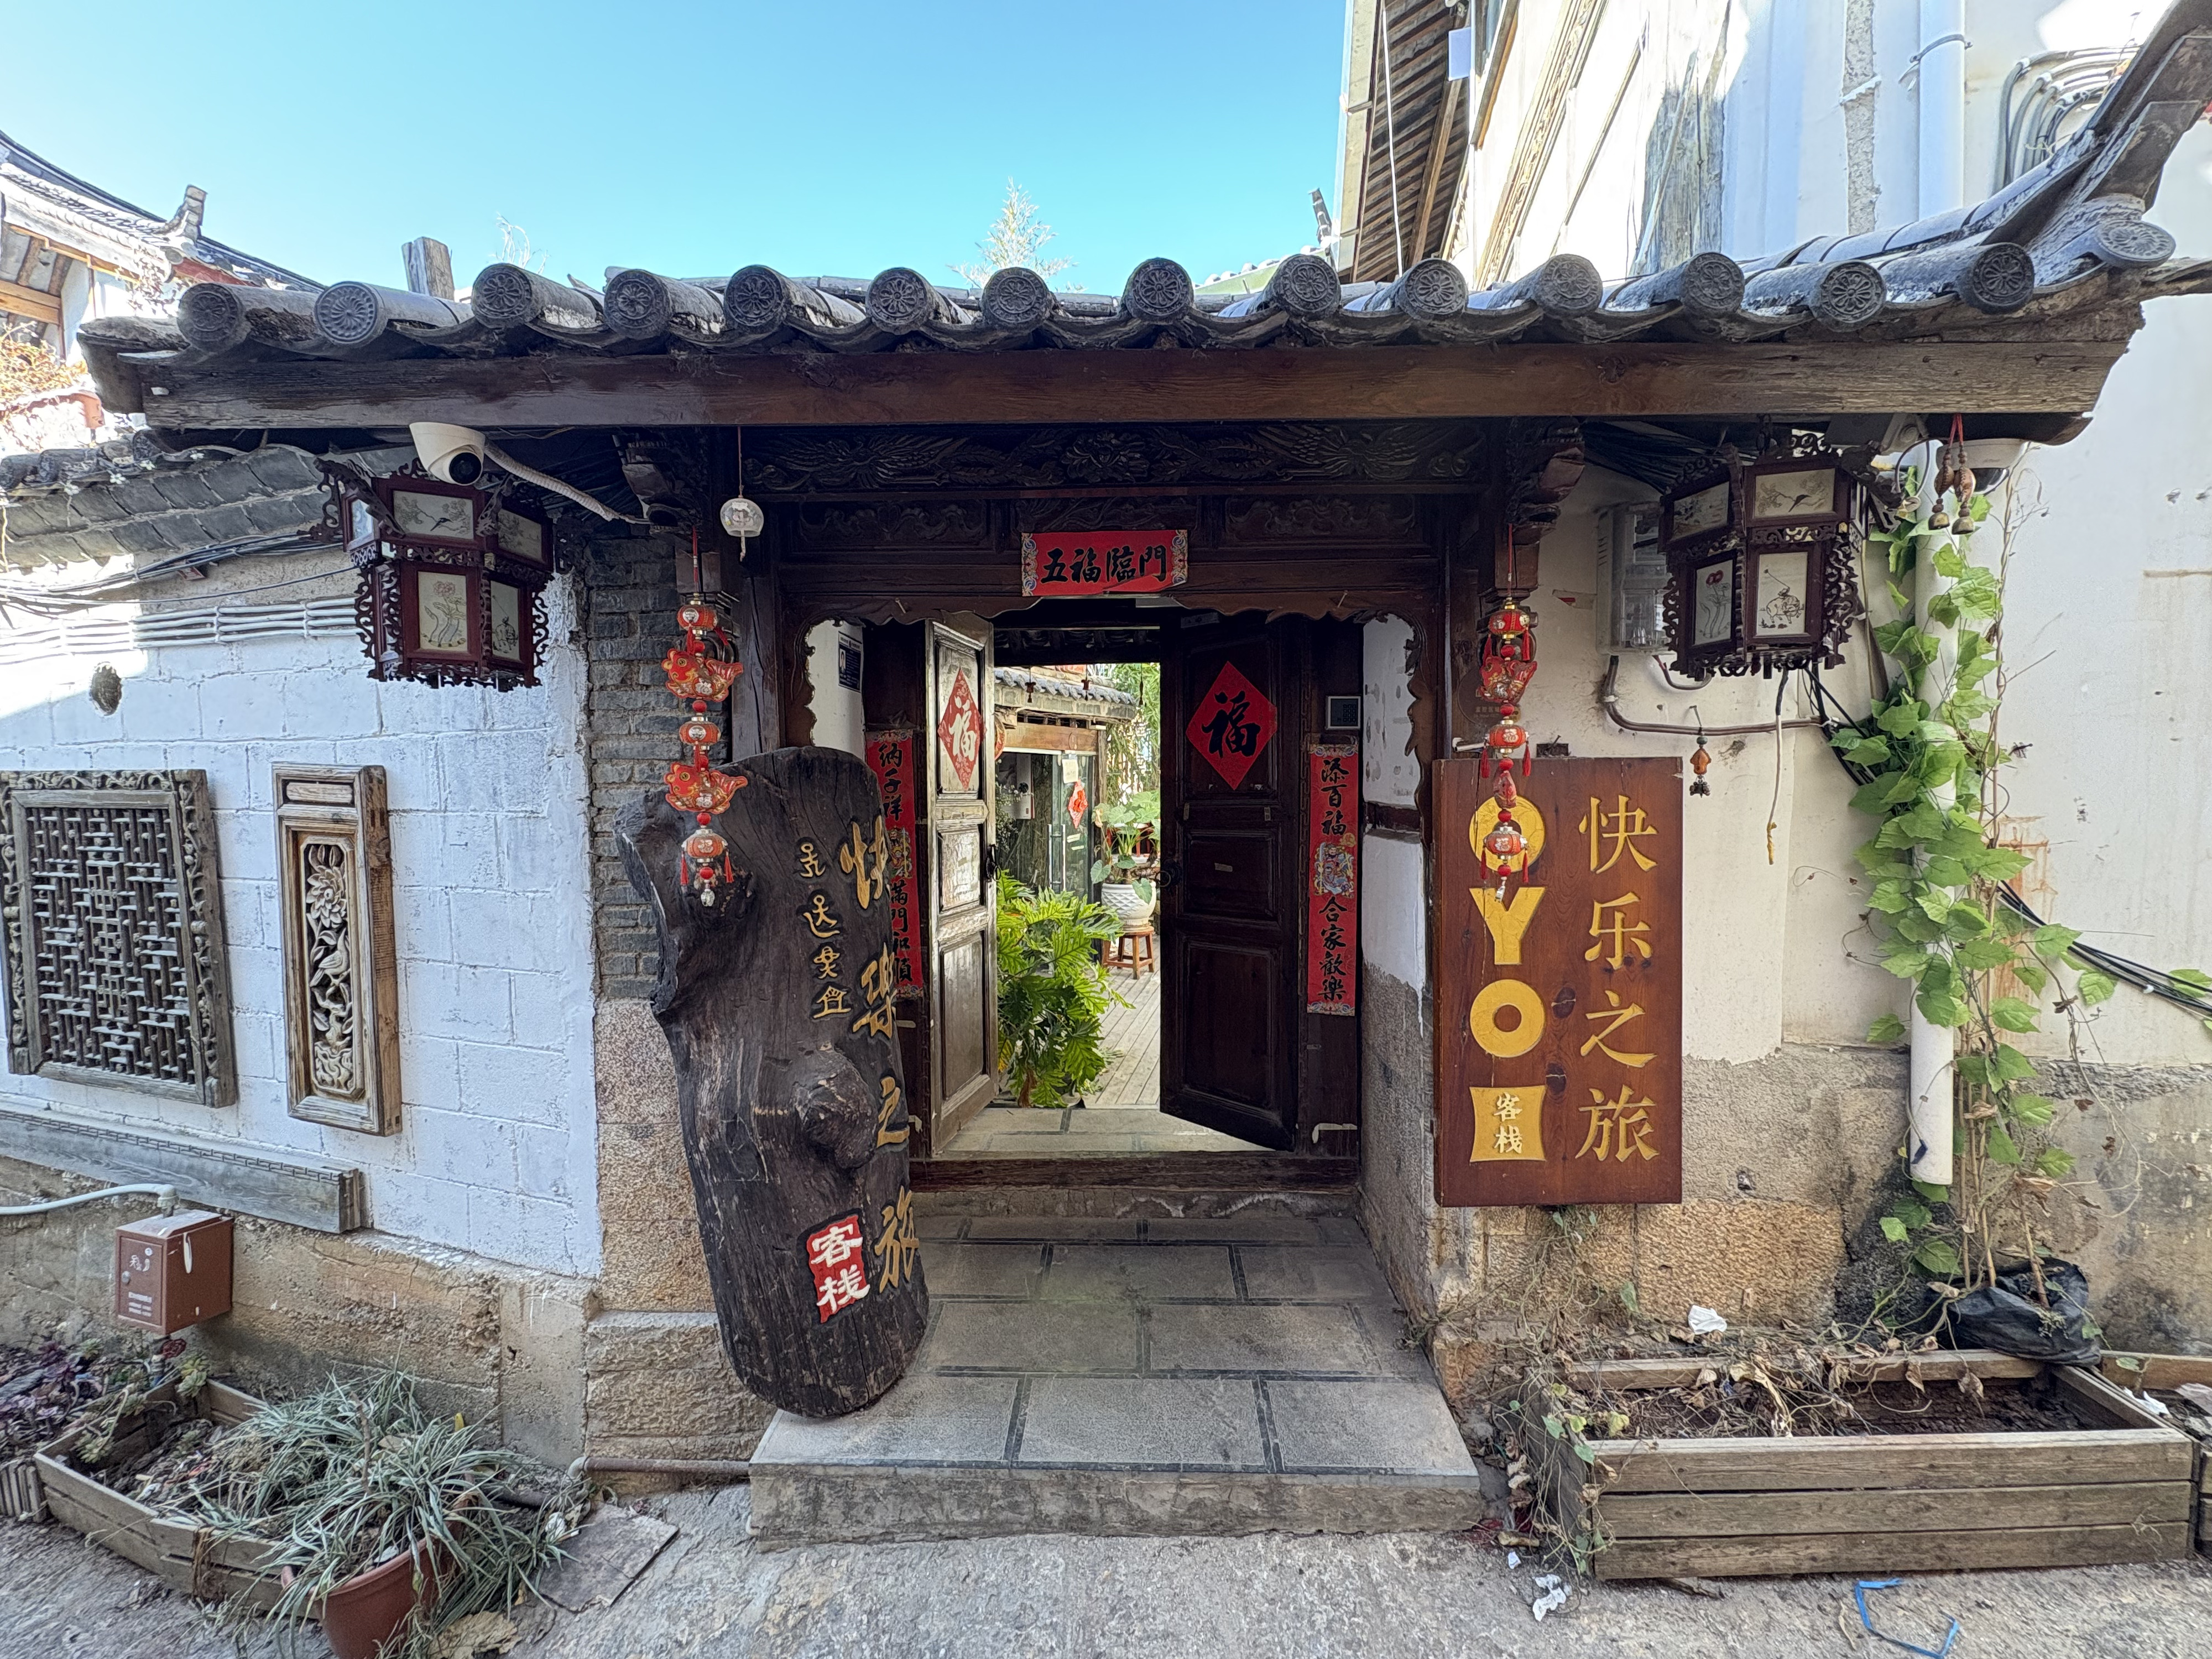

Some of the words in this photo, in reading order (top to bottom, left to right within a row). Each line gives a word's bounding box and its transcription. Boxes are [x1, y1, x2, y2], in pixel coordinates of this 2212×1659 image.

[1040, 545, 1167, 583] 五福臨門
[948, 695, 977, 762] 福
[1201, 690, 1261, 759] 福
[1319, 757, 1350, 836] 添百福
[1574, 794, 1660, 1163] 快乐之旅
[1493, 1093, 1524, 1155] 客栈
[809, 1223, 870, 1312] 客栈
